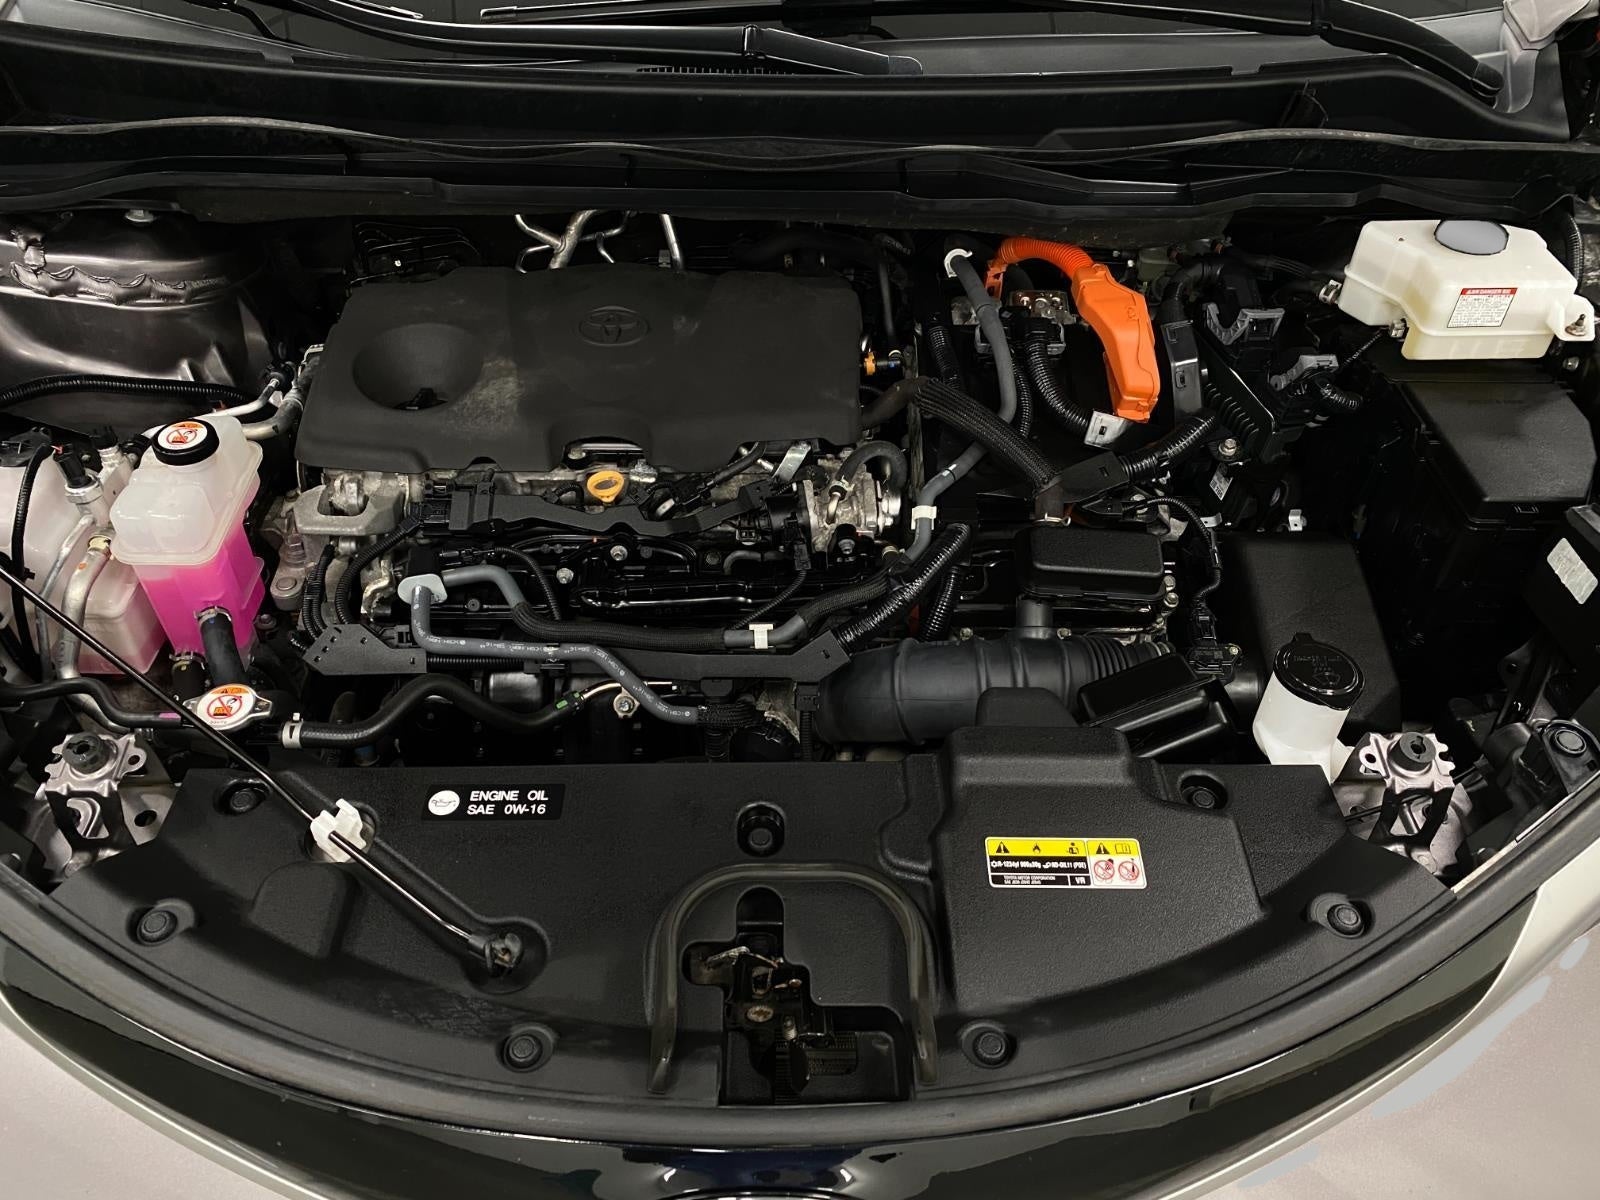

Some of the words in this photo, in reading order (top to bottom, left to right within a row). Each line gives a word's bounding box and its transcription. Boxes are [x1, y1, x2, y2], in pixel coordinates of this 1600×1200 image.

[469, 790, 520, 802] ENGINE
[527, 790, 549, 801] OIL
[467, 804, 495, 815] SAE
[504, 803, 546, 815] 0W-16
